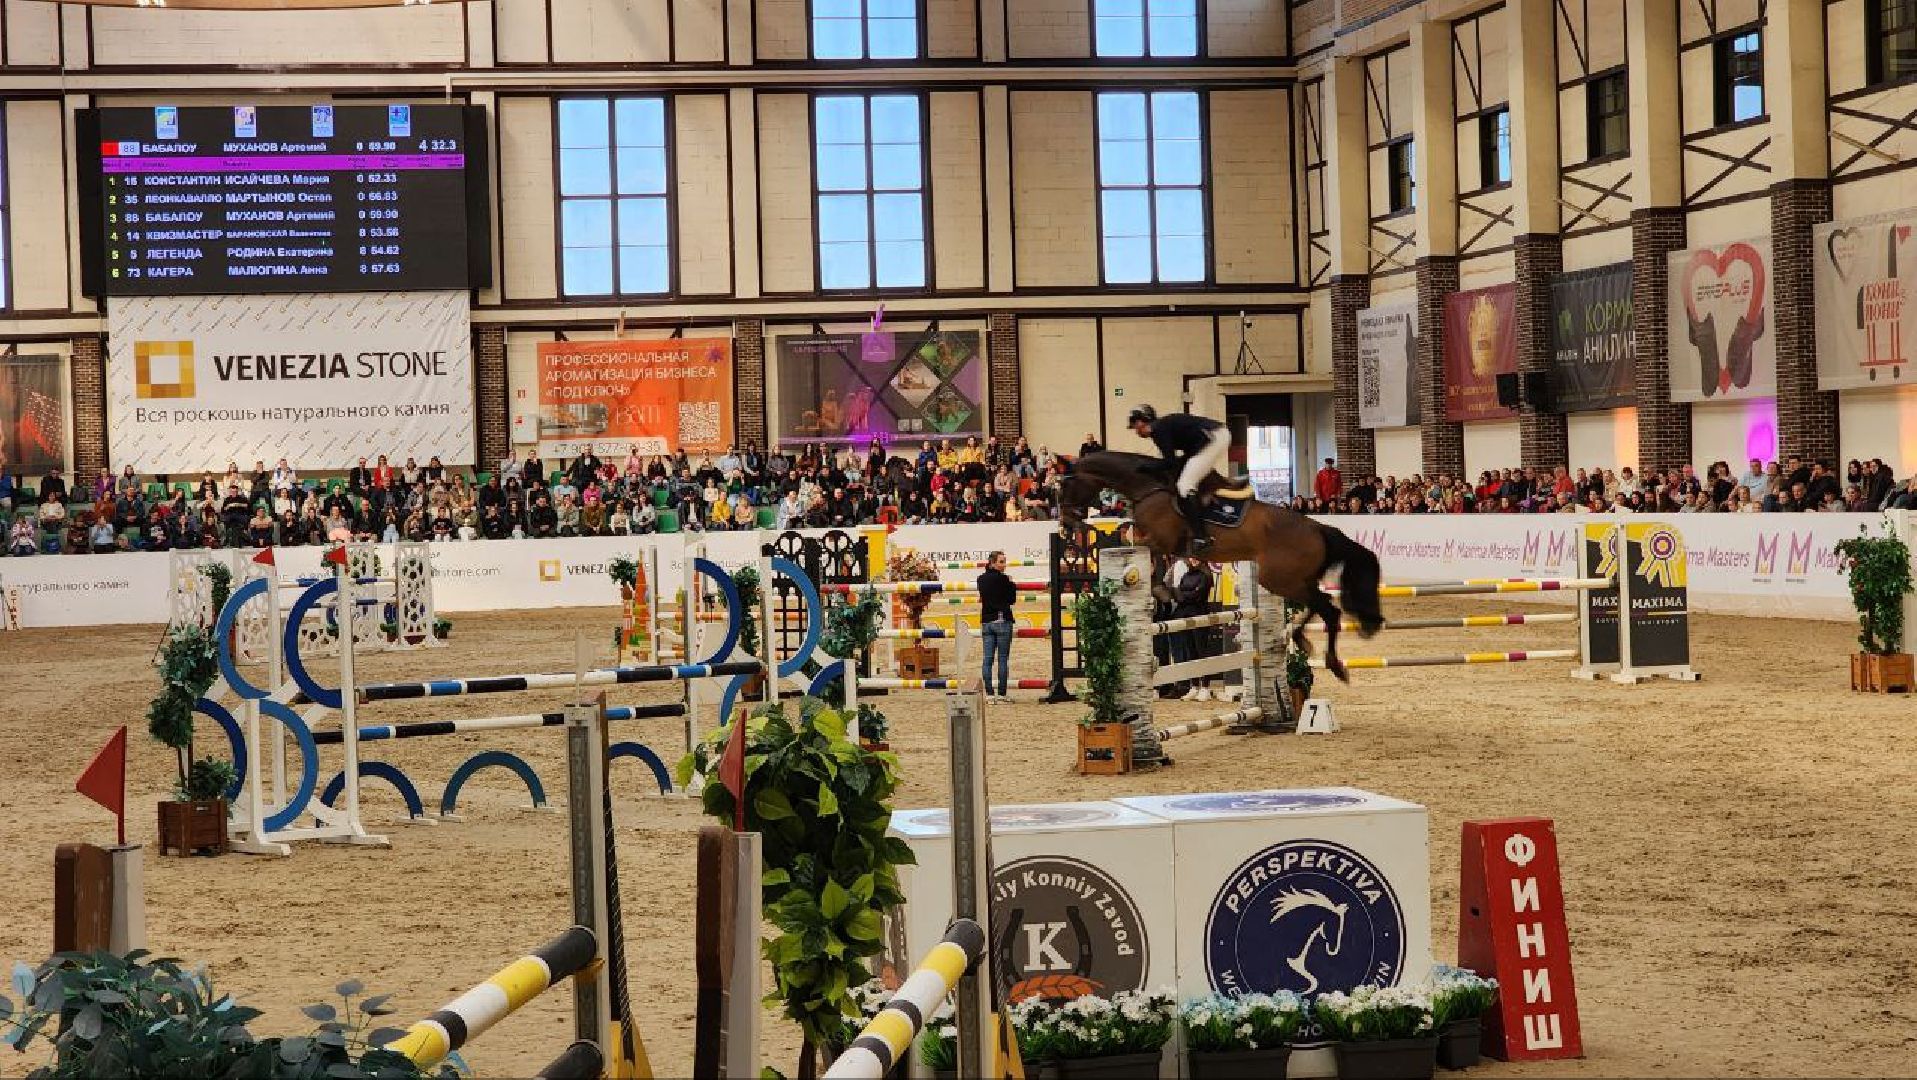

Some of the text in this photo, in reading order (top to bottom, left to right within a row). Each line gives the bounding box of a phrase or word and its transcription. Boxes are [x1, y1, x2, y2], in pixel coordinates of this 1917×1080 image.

[123, 143, 135, 153] 88
[142, 143, 197, 153] БАБАЛОУ
[223, 142, 278, 152] МУХАНОВ
[280, 142, 327, 153] Артемий
[431, 140, 456, 151] 32.3
[109, 177, 116, 186] 1
[144, 175, 221, 186] КОНСТАНТИН
[225, 173, 289, 185] ИСАЙЧЕВА
[293, 174, 330, 186] Мария
[356, 174, 364, 183] 0
[109, 196, 116, 205] 2
[145, 194, 222, 204] ЛЕОНКАВАЛЛО
[226, 193, 295, 203] МАРТЫНОВ
[299, 193, 332, 203] Остап
[357, 192, 365, 201] 0
[109, 214, 117, 223] 3
[145, 212, 203, 222] БАБАЛОУ
[226, 211, 284, 221] МУХАНОВ
[286, 211, 335, 222] Артемий
[358, 211, 366, 219] 0
[110, 232, 118, 242] 4
[126, 231, 140, 241] 14
[145, 230, 223, 240] КВИЗМАСТЕР
[145, 249, 203, 260] ЛЕГЕНДА
[226, 248, 273, 259] РОДИНА
[278, 247, 334, 258] Екатерина
[111, 268, 119, 278] 6
[127, 268, 141, 278] 73
[147, 267, 194, 277] КАГЕРА
[228, 265, 298, 276] МАЛЮГИНА
[299, 264, 328, 275] Анна
[1585, 298, 1634, 334] КОРМА
[213, 351, 448, 382] VENEZIA STONE
[545, 351, 689, 366] ПРОФЕССИОНАЛЬНАЯ
[545, 365, 717, 382] АРОМАТИЗАЦИЯ БИЗНЕСА
[546, 384, 631, 399] «ПОД КЛЮЧ»
[136, 402, 450, 425] Вся роскошь натурального камня
[1706, 545, 1750, 567] Masters
[1632, 596, 1684, 609] MAXIMA
[1309, 704, 1319, 728] 7
[1225, 850, 1383, 914] PERSPEKTIVA
[1021, 869, 1097, 899] Konniy
[1094, 891, 1136, 956] Zavod
[1022, 921, 1073, 972] K
[1504, 833, 1563, 1051] ФИНИШ
